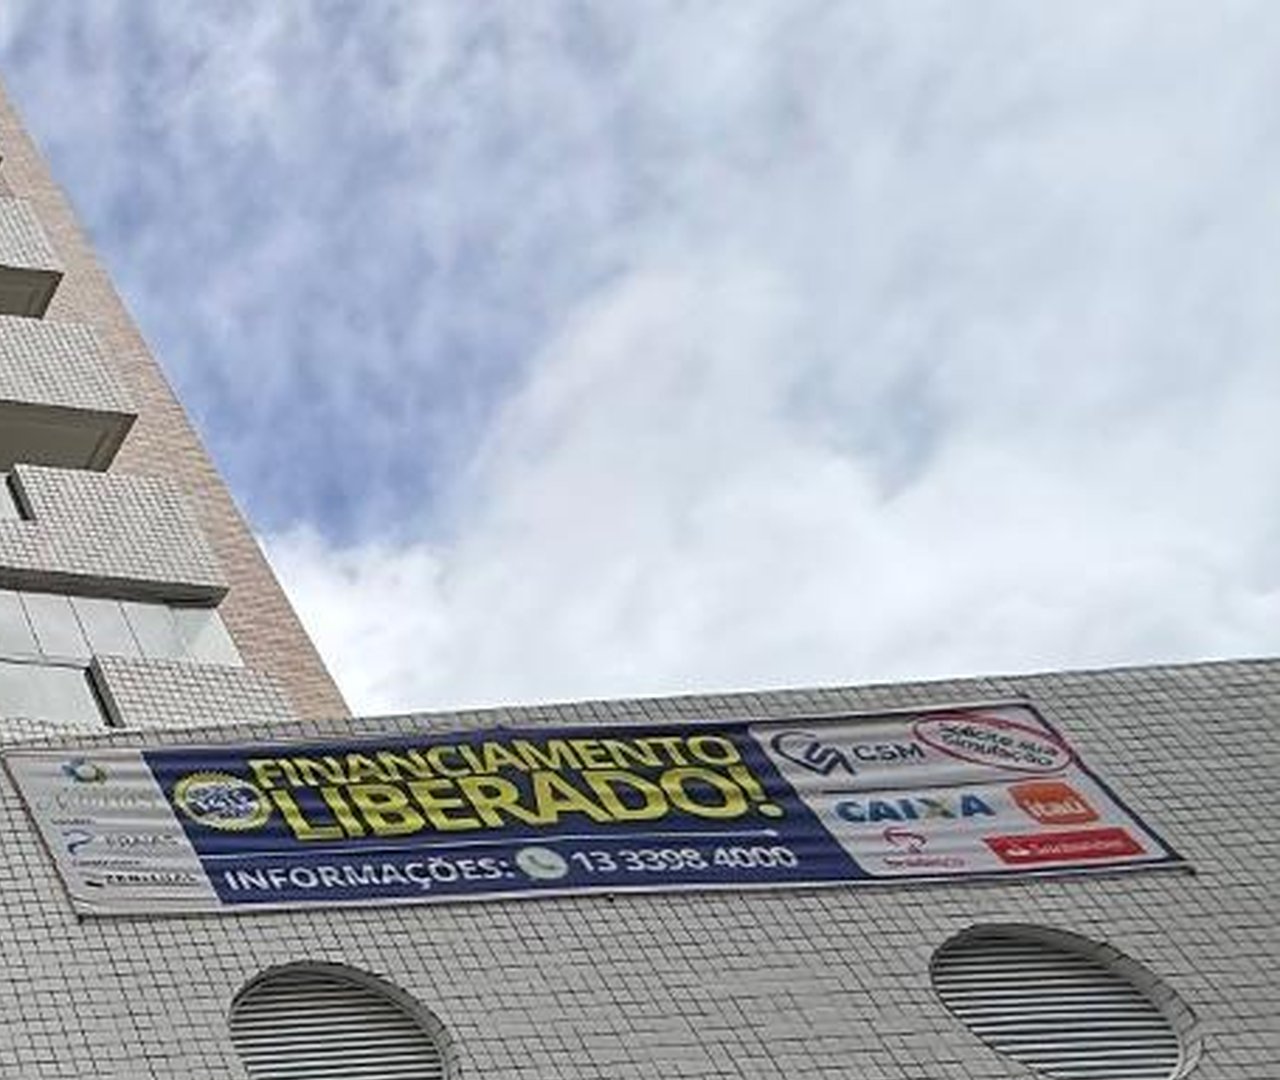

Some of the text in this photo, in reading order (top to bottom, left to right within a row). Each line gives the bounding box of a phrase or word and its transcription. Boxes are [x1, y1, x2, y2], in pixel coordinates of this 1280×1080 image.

[248, 735, 741, 788] FINANCIAMENTO
[852, 742, 927, 762] CSM
[271, 765, 784, 840] LIBERADO!
[834, 794, 997, 823] CAIXA
[223, 856, 517, 891] INFORMAÇÕES:
[571, 851, 618, 873] 13
[620, 848, 710, 872] 3398
[712, 846, 799, 869] 4000
